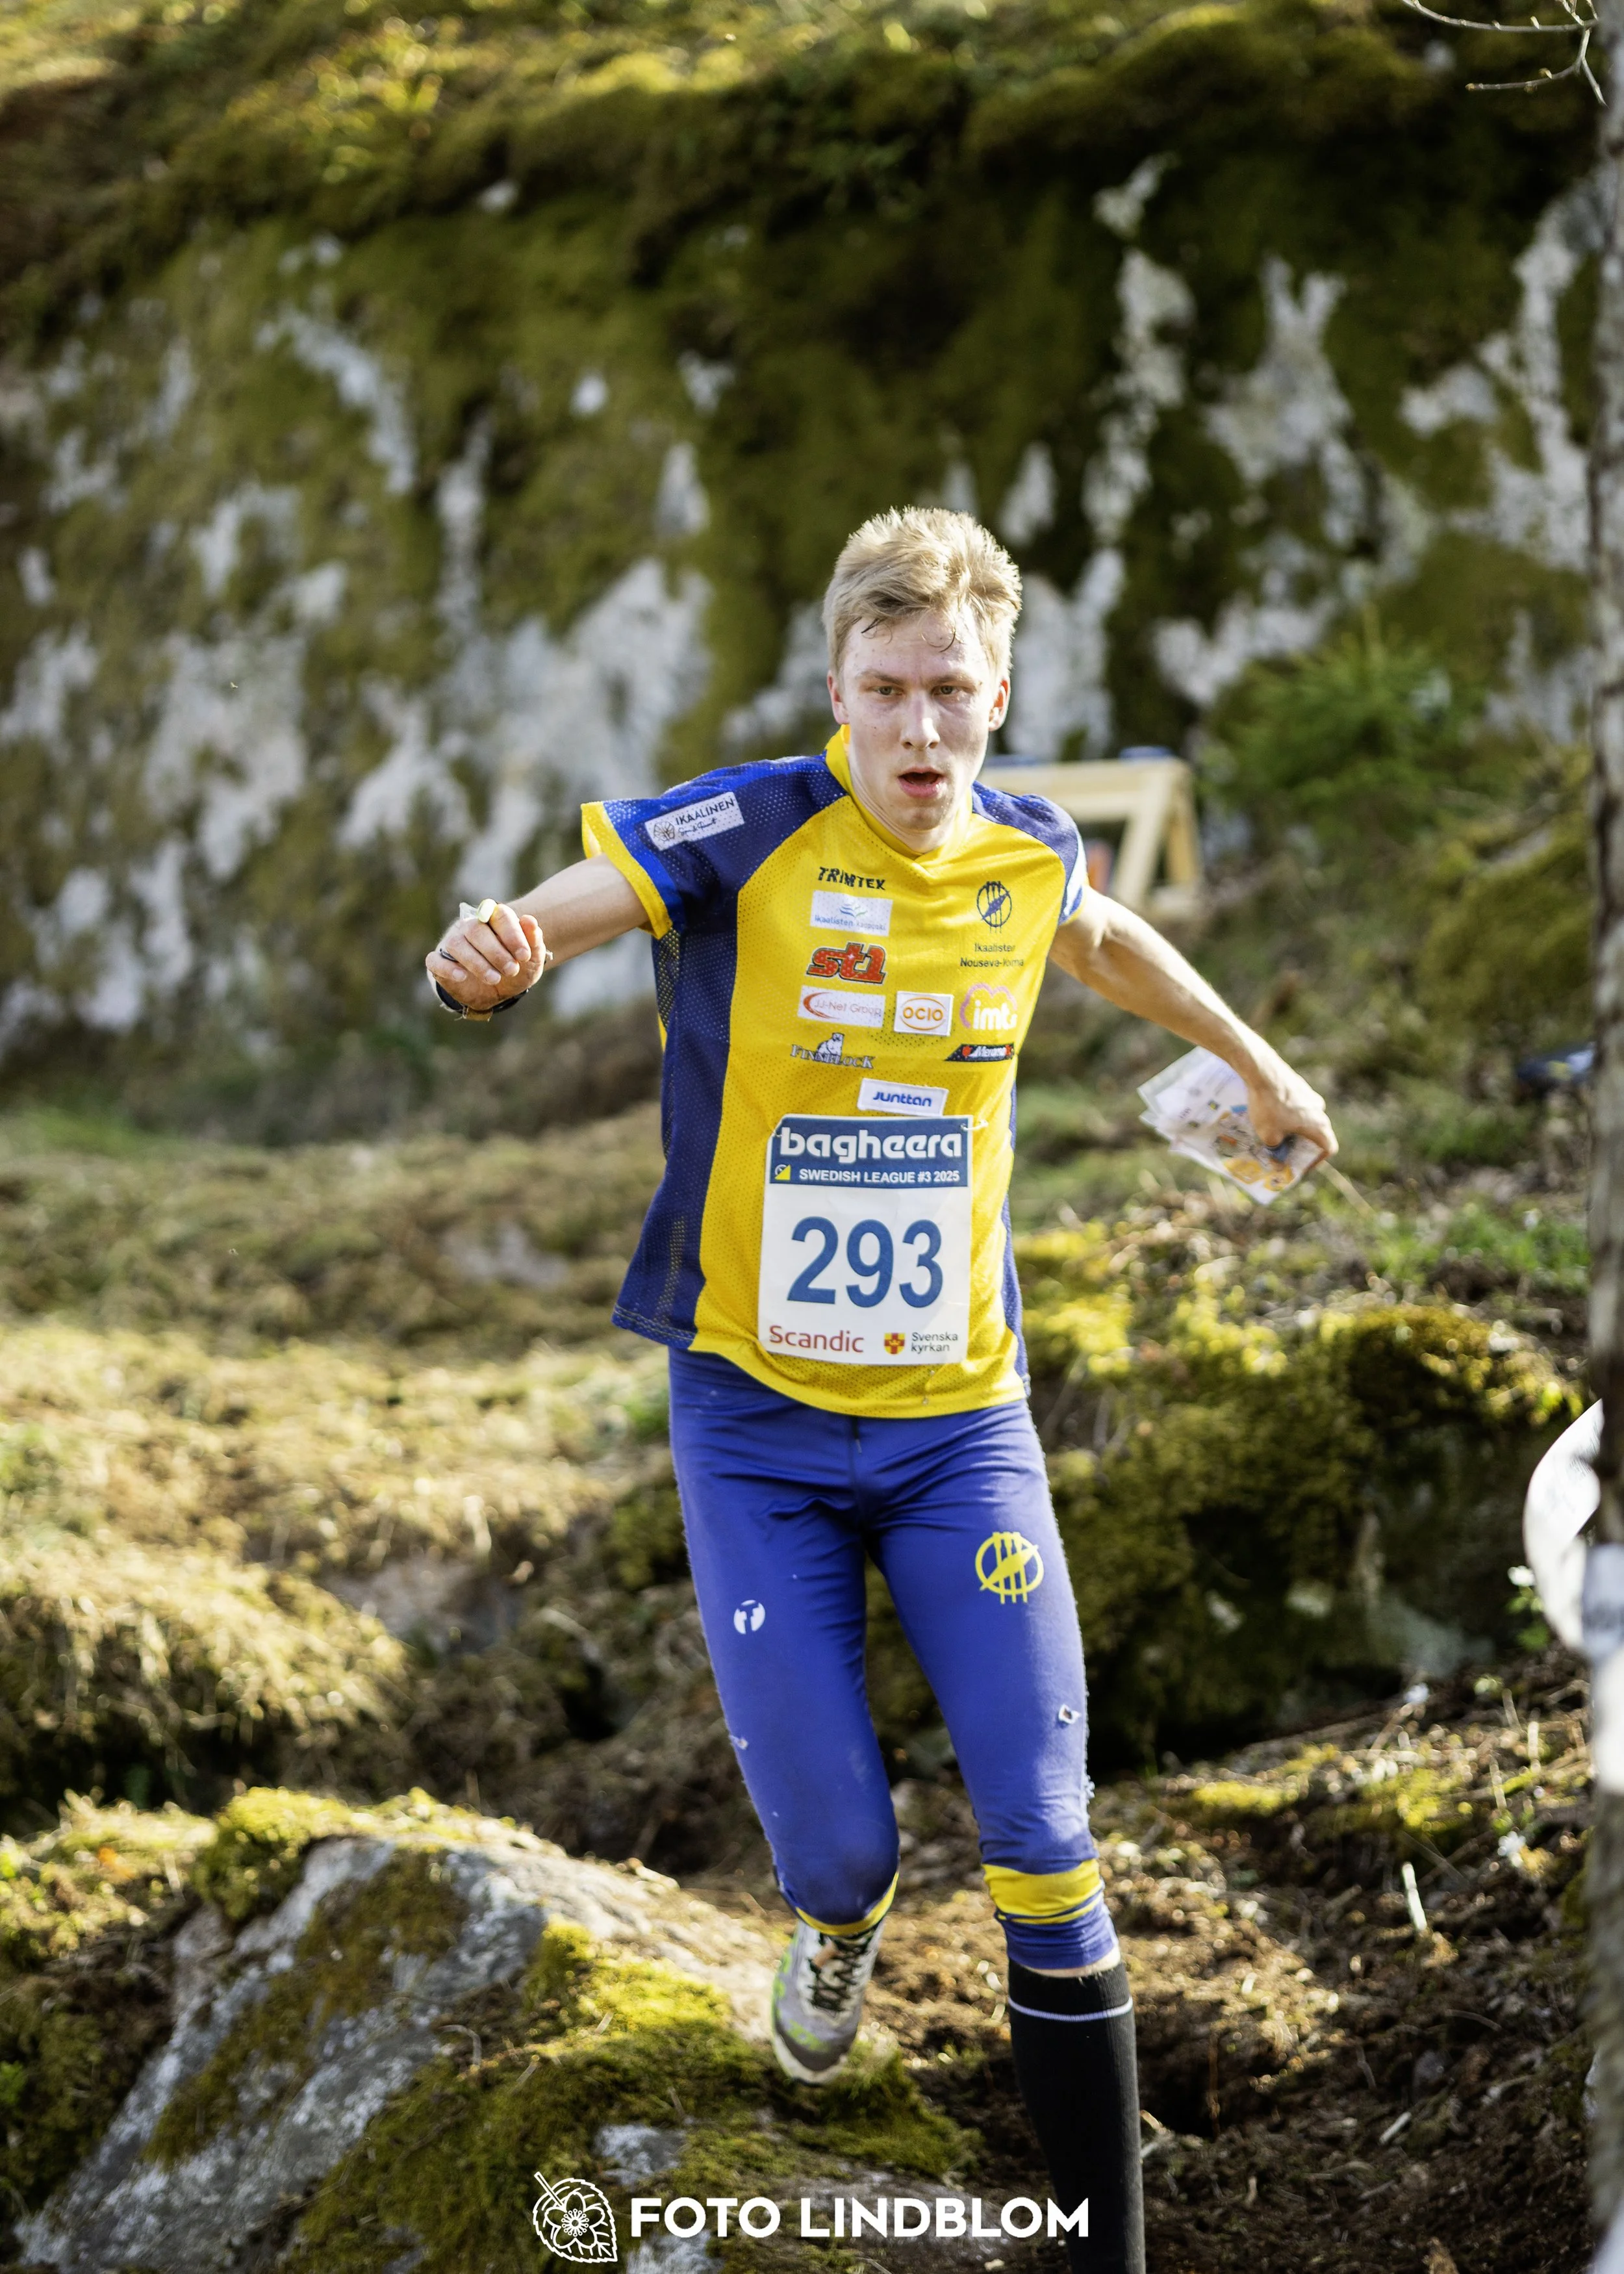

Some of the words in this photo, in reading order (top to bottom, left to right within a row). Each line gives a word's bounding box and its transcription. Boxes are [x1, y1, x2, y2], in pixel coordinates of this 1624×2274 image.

[676, 798, 735, 826] IKAALINEN
[818, 867, 886, 890] TRIMTEX
[780, 1127, 962, 1164] bagheera
[799, 1168, 861, 1182] SWEDISH
[863, 1170, 915, 1183] LEAGUE
[917, 1170, 932, 1182] #3
[933, 1170, 960, 1182] 2025
[787, 1216, 944, 1309] 293
[769, 1325, 865, 1353] Scandic
[911, 1331, 958, 1342] Svenska
[911, 1342, 951, 1355] kyrkan
